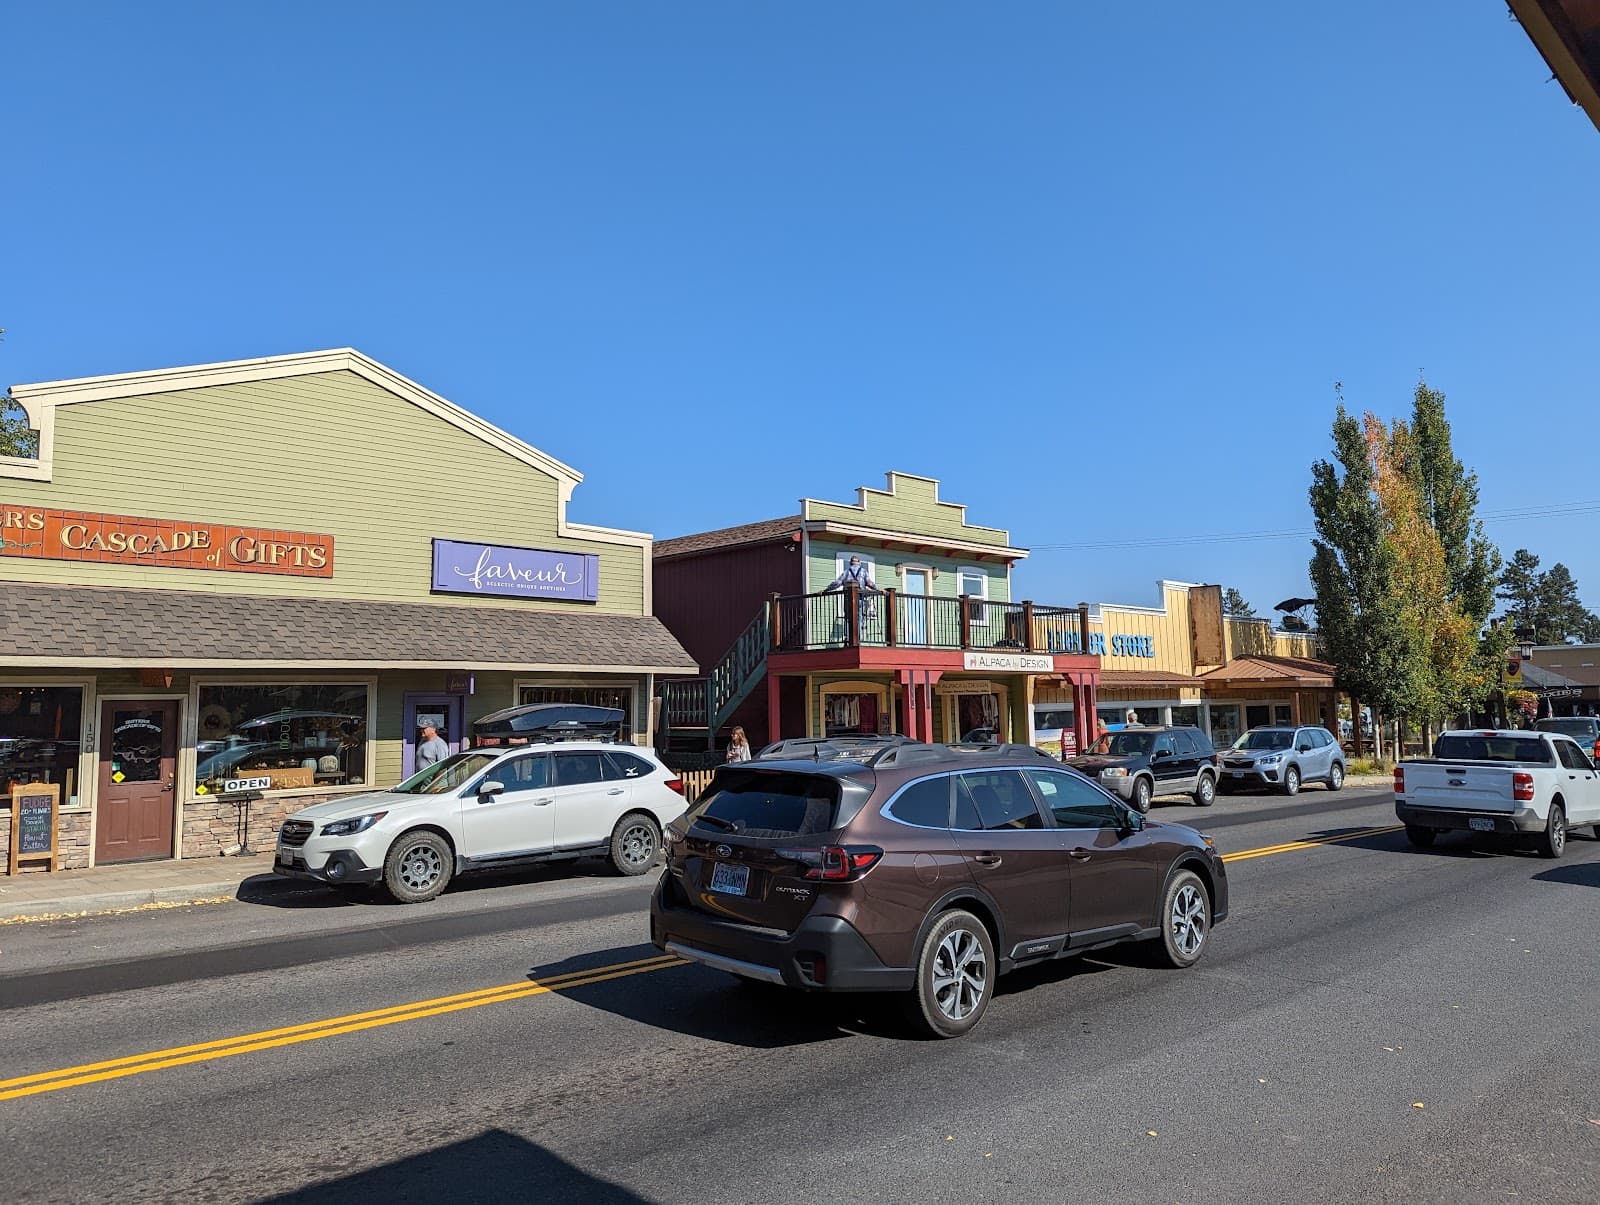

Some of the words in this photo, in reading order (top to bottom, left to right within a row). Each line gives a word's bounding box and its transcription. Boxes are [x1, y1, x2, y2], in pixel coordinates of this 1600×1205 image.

[0, 510, 45, 530] RS
[60, 525, 211, 554] CASCADE
[206, 547, 224, 567] of
[229, 535, 327, 568] GIFTS
[454, 546, 584, 590] faveur
[1112, 634, 1155, 658] STORE
[979, 656, 1012, 668] ALPACA
[1020, 657, 1049, 668] DESIGN
[227, 778, 268, 790] OPEN
